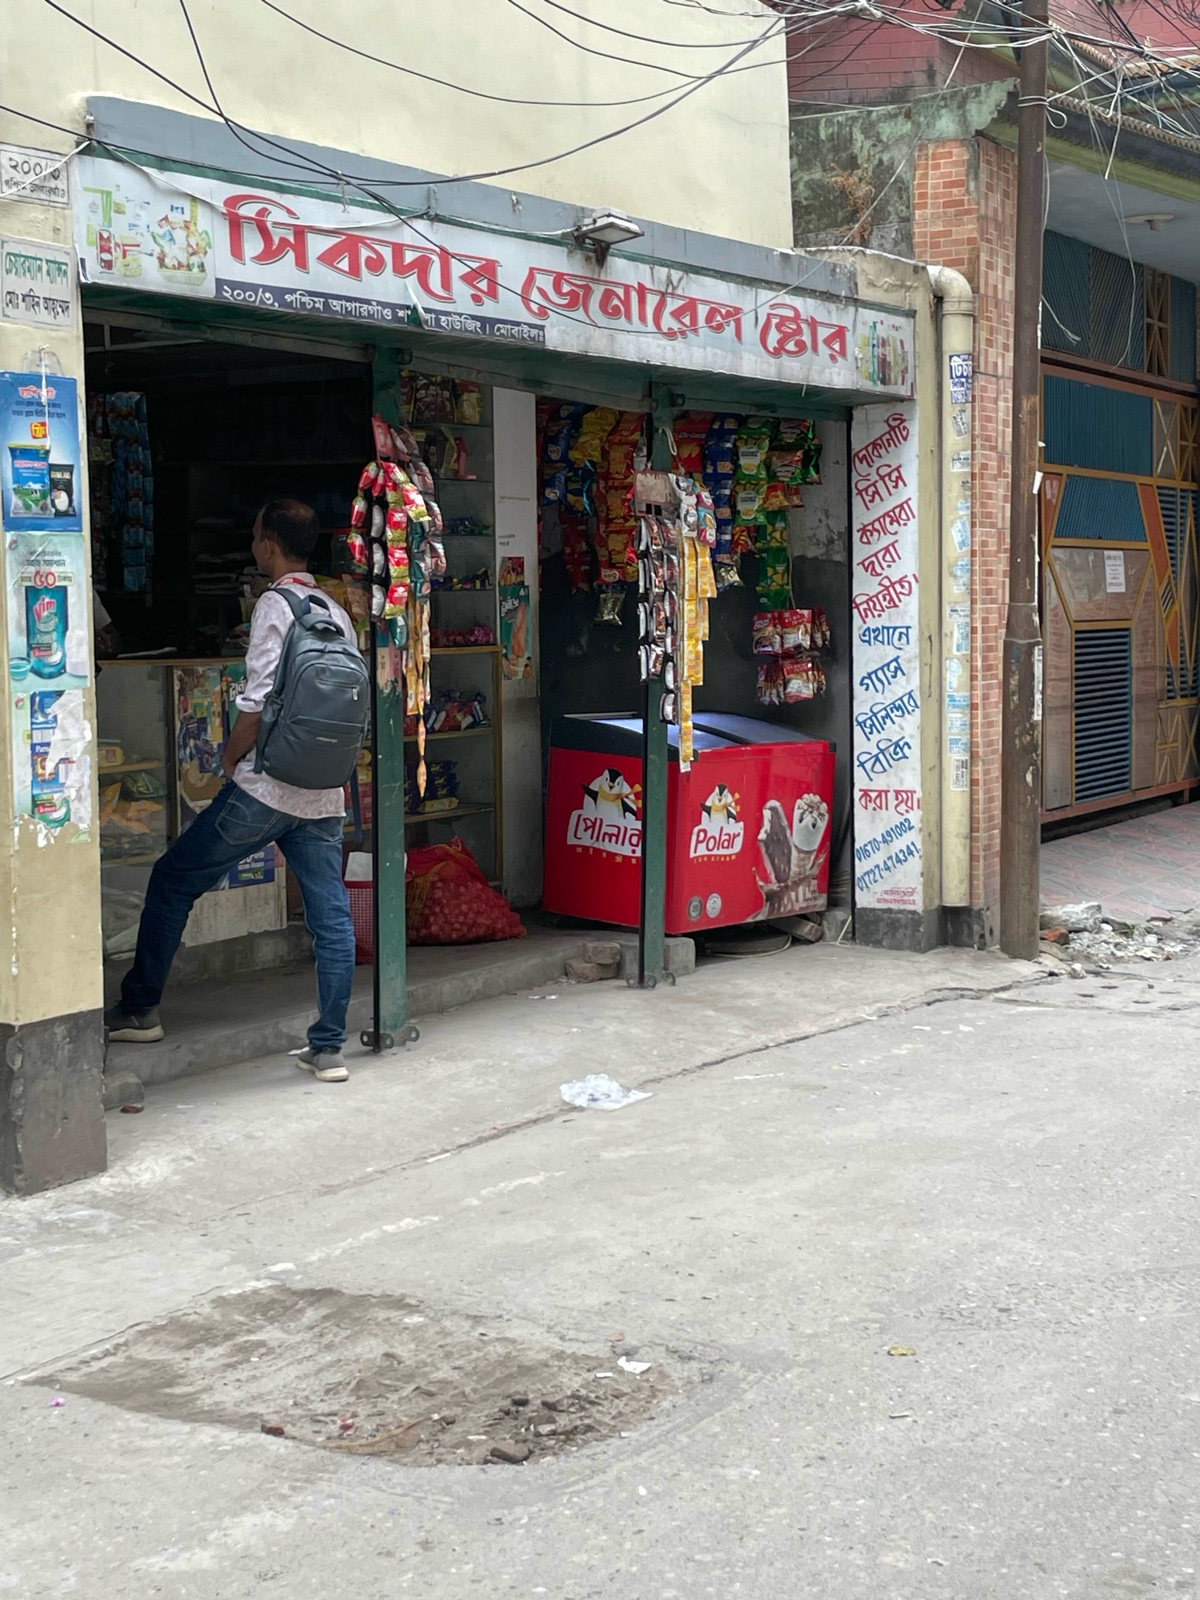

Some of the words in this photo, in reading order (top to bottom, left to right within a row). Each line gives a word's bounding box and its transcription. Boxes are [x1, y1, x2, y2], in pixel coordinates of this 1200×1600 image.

[222, 193, 503, 306] সিকদার
[521, 266, 743, 341] জেনারেল
[222, 284, 279, 309] ২০০/৩,
[284, 292, 324, 311] পশ্চিম
[329, 297, 392, 321] আগারগাঁও
[852, 412, 910, 477] দোকানটি
[855, 478, 885, 511] সি
[877, 464, 908, 497] সি
[857, 497, 917, 545] ক্যামেরা
[856, 538, 902, 577] দ্বারা
[34, 570, 57, 588] ৫০
[33, 595, 57, 623] Vim
[859, 624, 912, 651] এখানে
[859, 656, 906, 695] গ্যাস
[855, 689, 920, 742] সিলিন্ডার
[856, 736, 912, 782] বিক্রি
[858, 788, 890, 811] করা
[573, 812, 642, 855] পোলার
[694, 825, 742, 854] Polar
[855, 817, 915, 863] 01670-491002
